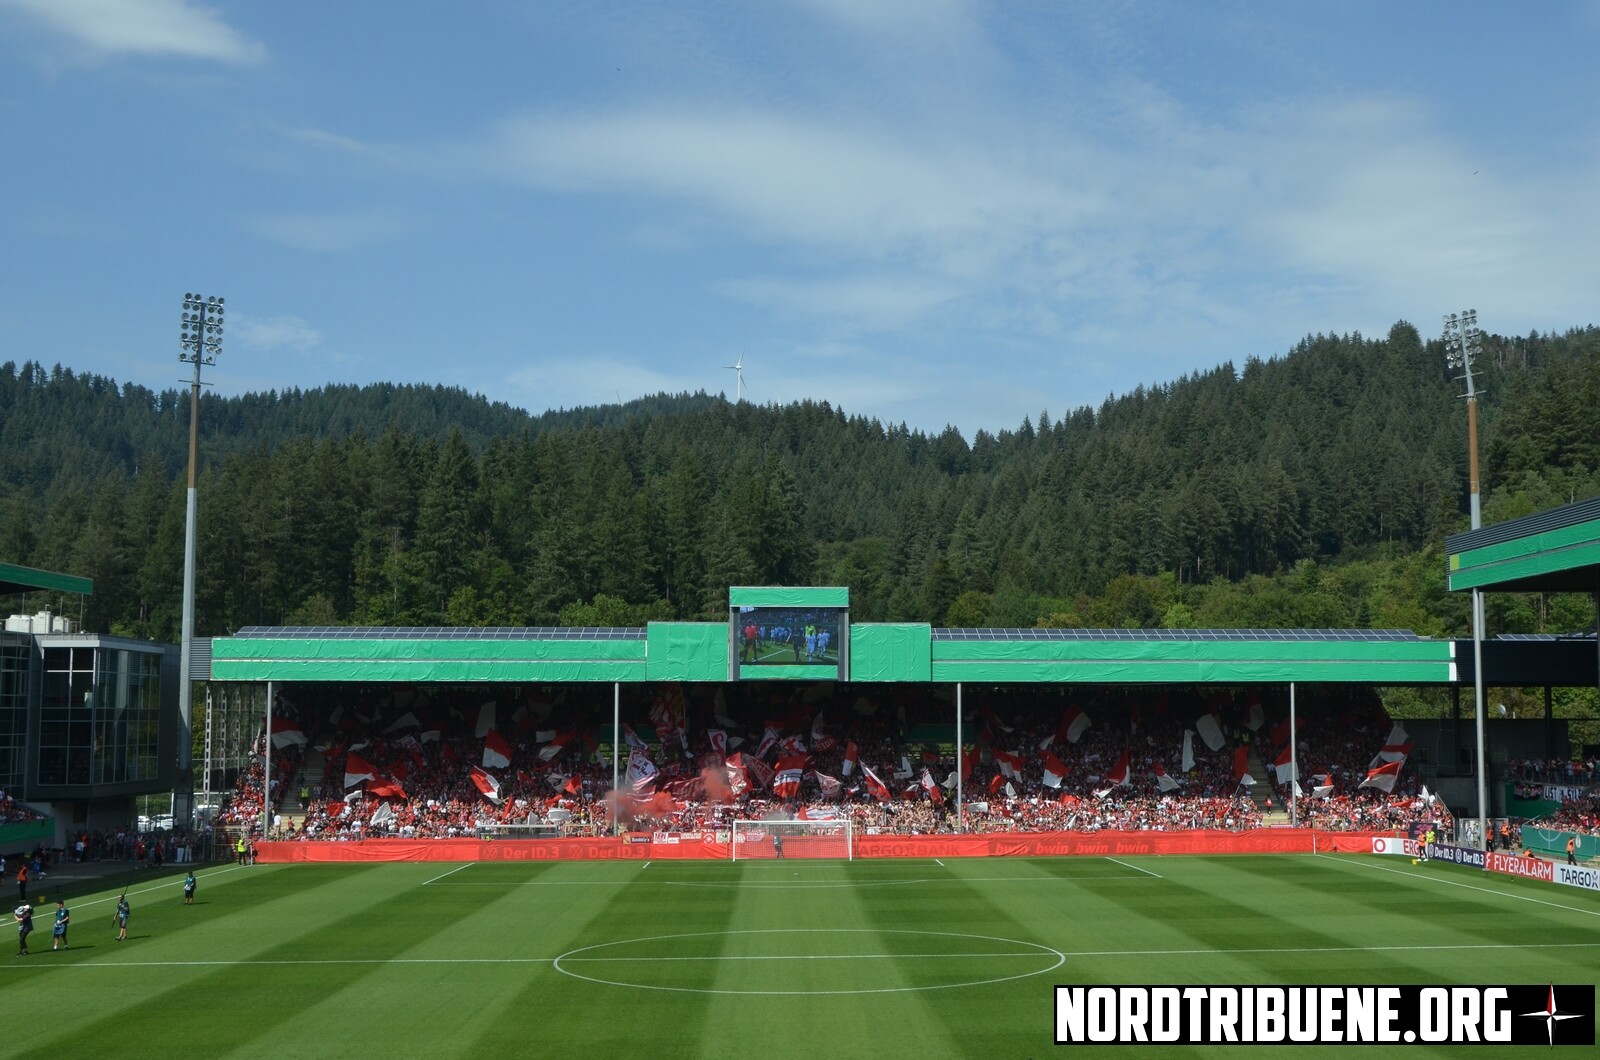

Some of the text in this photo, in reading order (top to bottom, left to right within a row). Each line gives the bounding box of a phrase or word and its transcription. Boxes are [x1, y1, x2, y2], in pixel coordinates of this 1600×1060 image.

[503, 847, 528, 859] Der
[531, 846, 560, 859] ID.3
[589, 847, 613, 859] Der
[616, 846, 645, 858] ID.3
[1035, 842, 1069, 855] bwin
[1075, 842, 1109, 854] bwin
[1116, 842, 1149, 853] bwin
[1403, 840, 1424, 857] ERG
[1434, 846, 1454, 860] Der ID.3
[1463, 853, 1484, 866] Der ID.3
[1494, 854, 1552, 878] FLYERALARM
